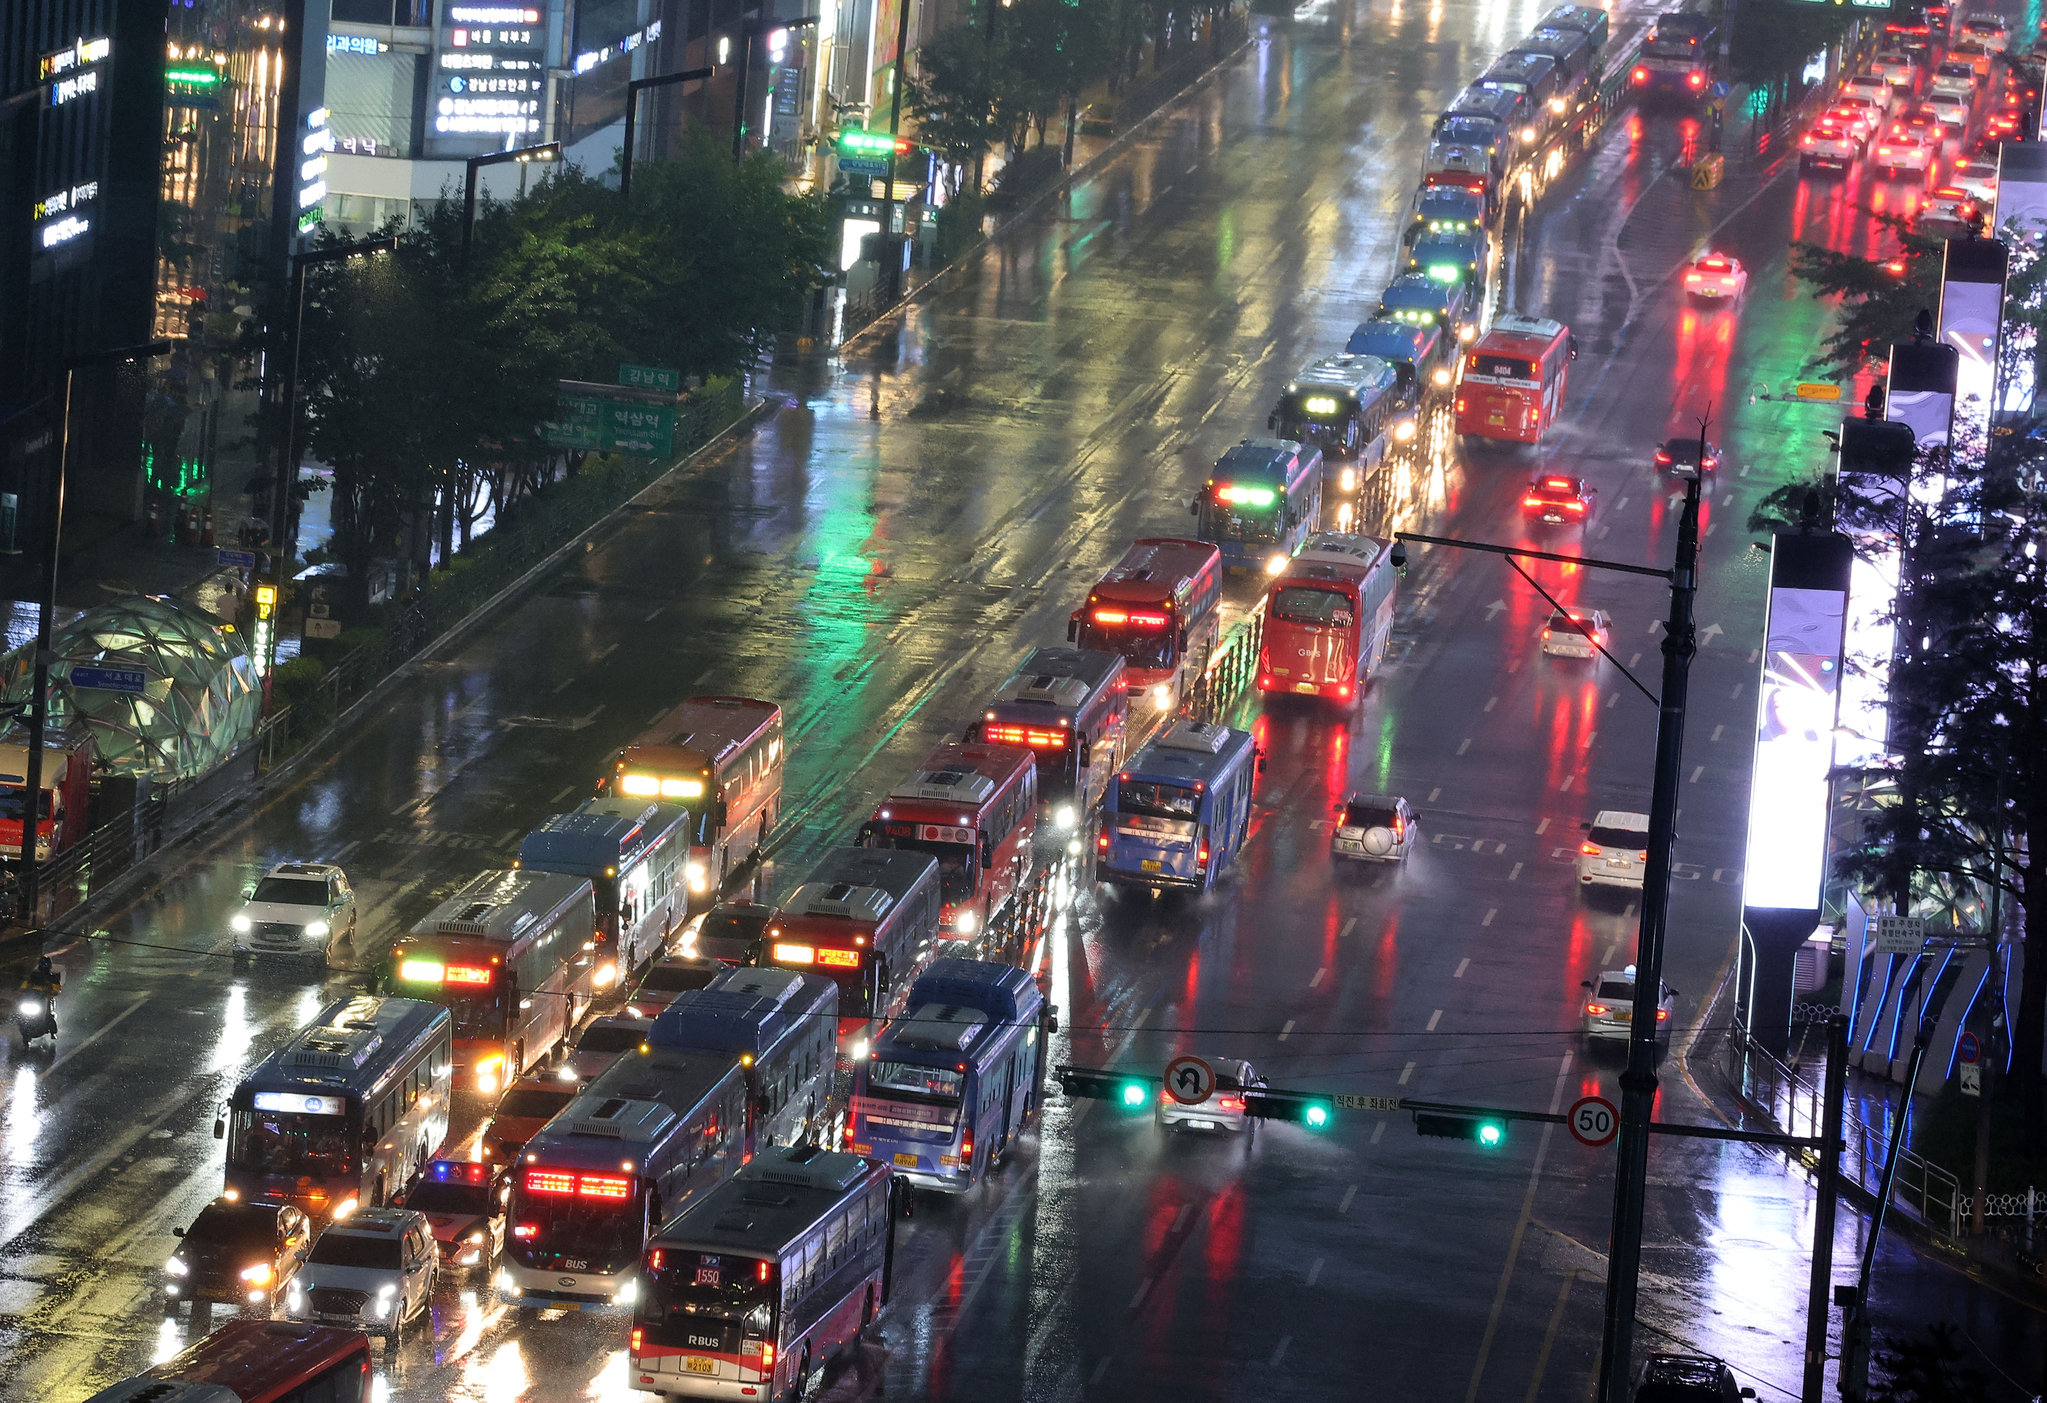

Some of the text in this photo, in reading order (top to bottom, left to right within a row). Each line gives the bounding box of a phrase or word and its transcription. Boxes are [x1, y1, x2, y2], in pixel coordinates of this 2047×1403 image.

[629, 368, 670, 386] 강남역
[614, 410, 660, 429] 역삼역
[259, 604, 271, 614] 10
[104, 670, 143, 683] 서초대로
[1174, 798, 1193, 809] 421
[884, 825, 912, 837] 9408
[933, 1081, 956, 1095] 441
[1336, 1094, 1397, 1111] 직진 후 좌회전
[1578, 1109, 1610, 1133] 50
[564, 1259, 588, 1270] BUS
[696, 1268, 720, 1284] 1550
